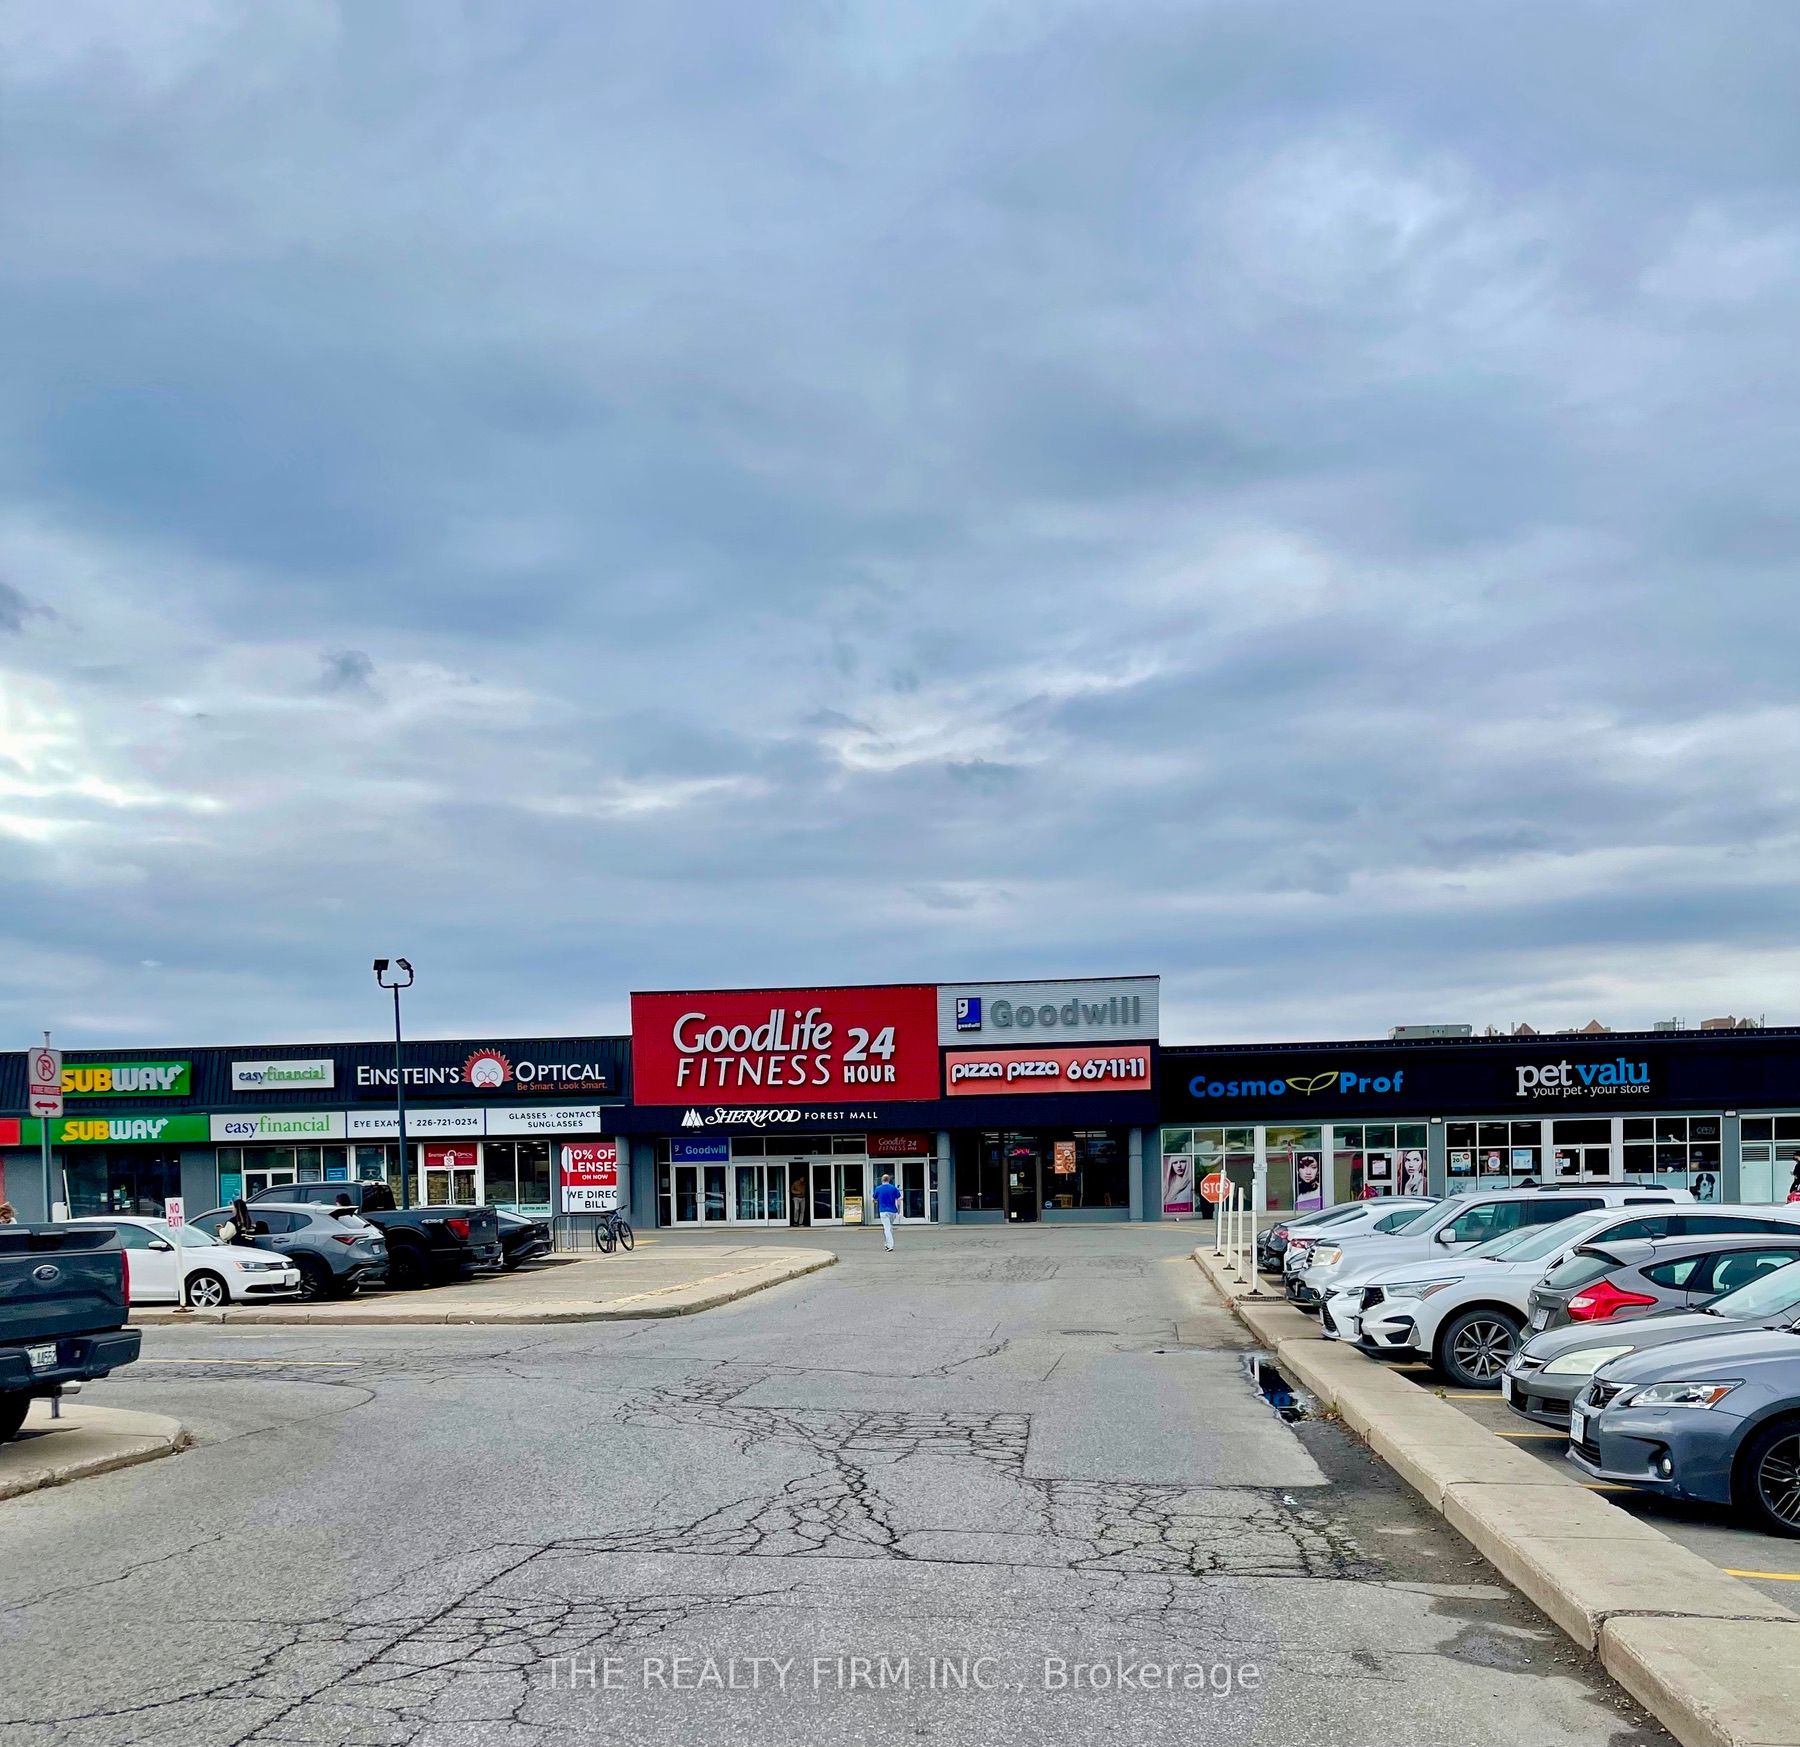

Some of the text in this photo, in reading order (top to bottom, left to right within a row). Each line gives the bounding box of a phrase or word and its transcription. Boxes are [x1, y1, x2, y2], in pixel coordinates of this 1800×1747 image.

[990, 996, 1140, 1027] Goodwill
[673, 1008, 832, 1053] GoodLife
[843, 1027, 896, 1061] 24
[61, 1065, 184, 1093] SUBWAY
[676, 1054, 832, 1086] FITNESS
[843, 1065, 896, 1083] HOUR
[951, 1062, 1003, 1084] pizza
[1007, 1061, 1060, 1084] pizza
[1516, 1057, 1649, 1096] pet valu
[517, 1083, 528, 1091] Be
[559, 1081, 580, 1090] Look
[1188, 1071, 1403, 1098] Cosmo Prof
[1533, 1085, 1650, 1098] your pet your store
[416, 1118, 478, 1127] 226-721-0234
[528, 1120, 583, 1128] SUNGLASSES
[705, 1107, 878, 1128] SHERWOOD FOREST MALL
[60, 1117, 169, 1142] SUBWAY
[685, 1145, 727, 1155] Goodwill
[169, 1202, 179, 1213] NO
[168, 1216, 183, 1228] EXIT
